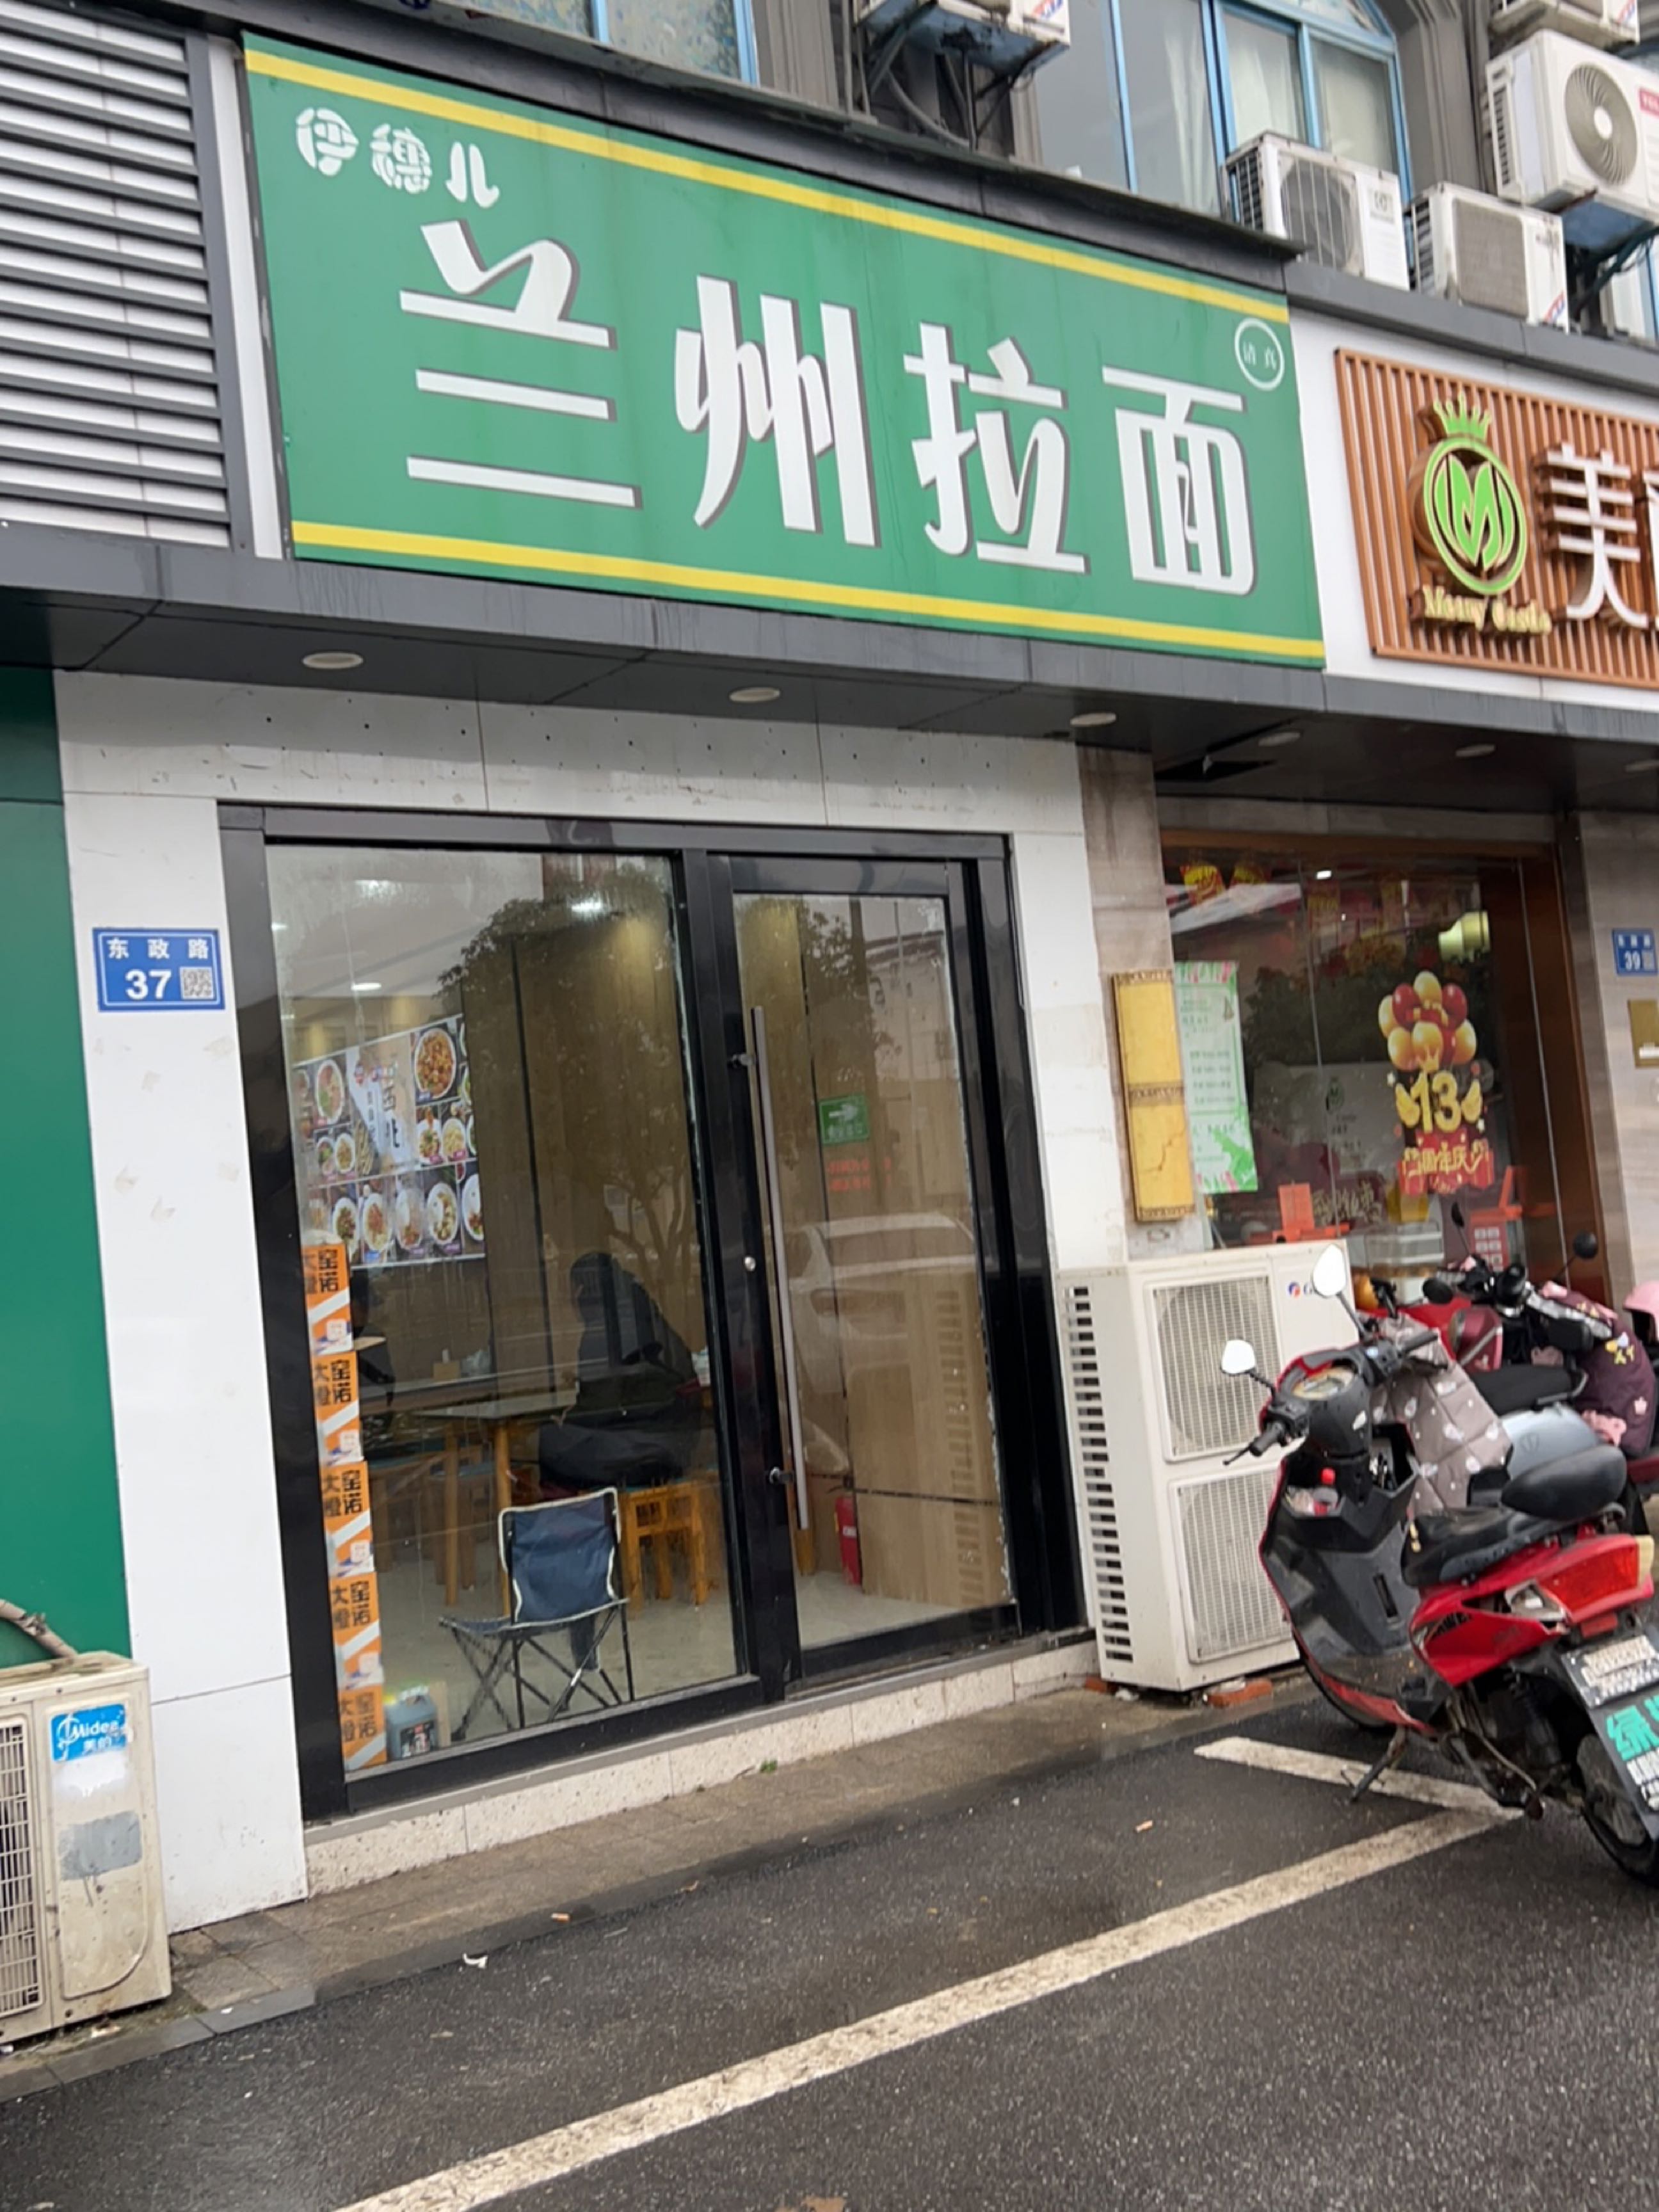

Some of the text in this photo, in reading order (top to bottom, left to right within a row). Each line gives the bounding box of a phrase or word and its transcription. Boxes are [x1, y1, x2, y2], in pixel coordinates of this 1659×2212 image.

[399, 219, 1257, 597] 兰州拉面
[106, 936, 209, 959] 东政路
[125, 969, 172, 1000] 37
[1410, 1071, 1462, 1134] 13
[1606, 1694, 1659, 1761] 绿
